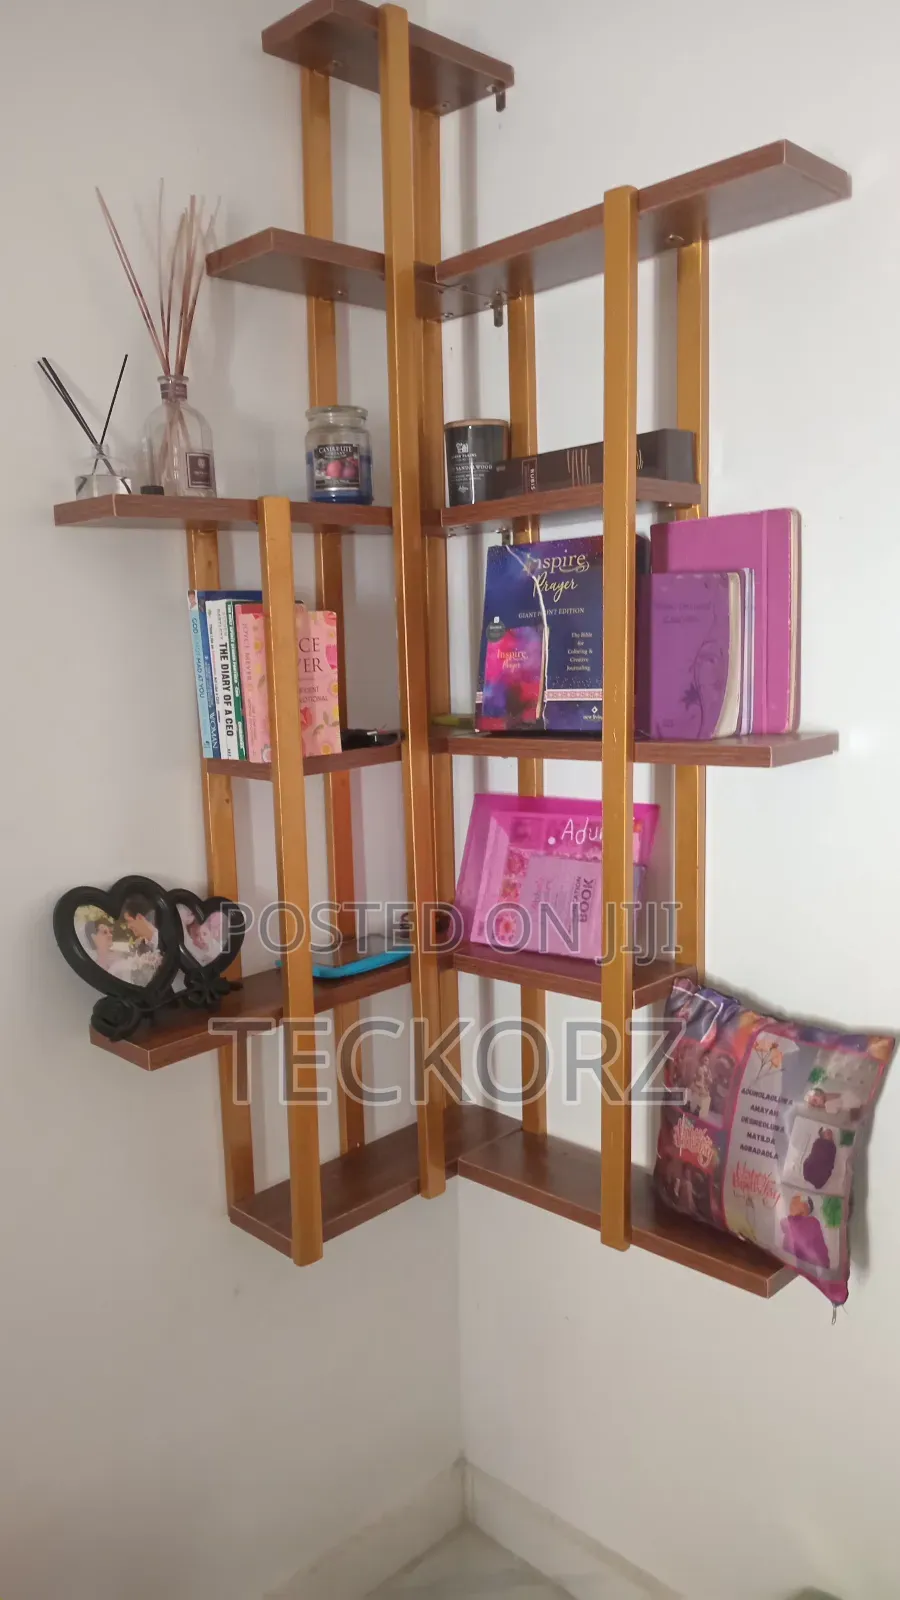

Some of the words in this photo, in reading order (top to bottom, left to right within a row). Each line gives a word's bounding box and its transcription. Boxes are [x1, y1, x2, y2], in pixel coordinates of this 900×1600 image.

[518, 611, 537, 619] GIANT
[537, 609, 558, 617] PINT
[558, 607, 585, 616] EDITION
[219, 642, 229, 661] THE
[220, 664, 231, 691] DIARY
[223, 694, 232, 707] OF
[209, 711, 219, 749] WOMAN
[225, 718, 234, 737] CEO
[580, 878, 594, 923] BOOK
[747, 1131, 776, 1145] MATILDA
